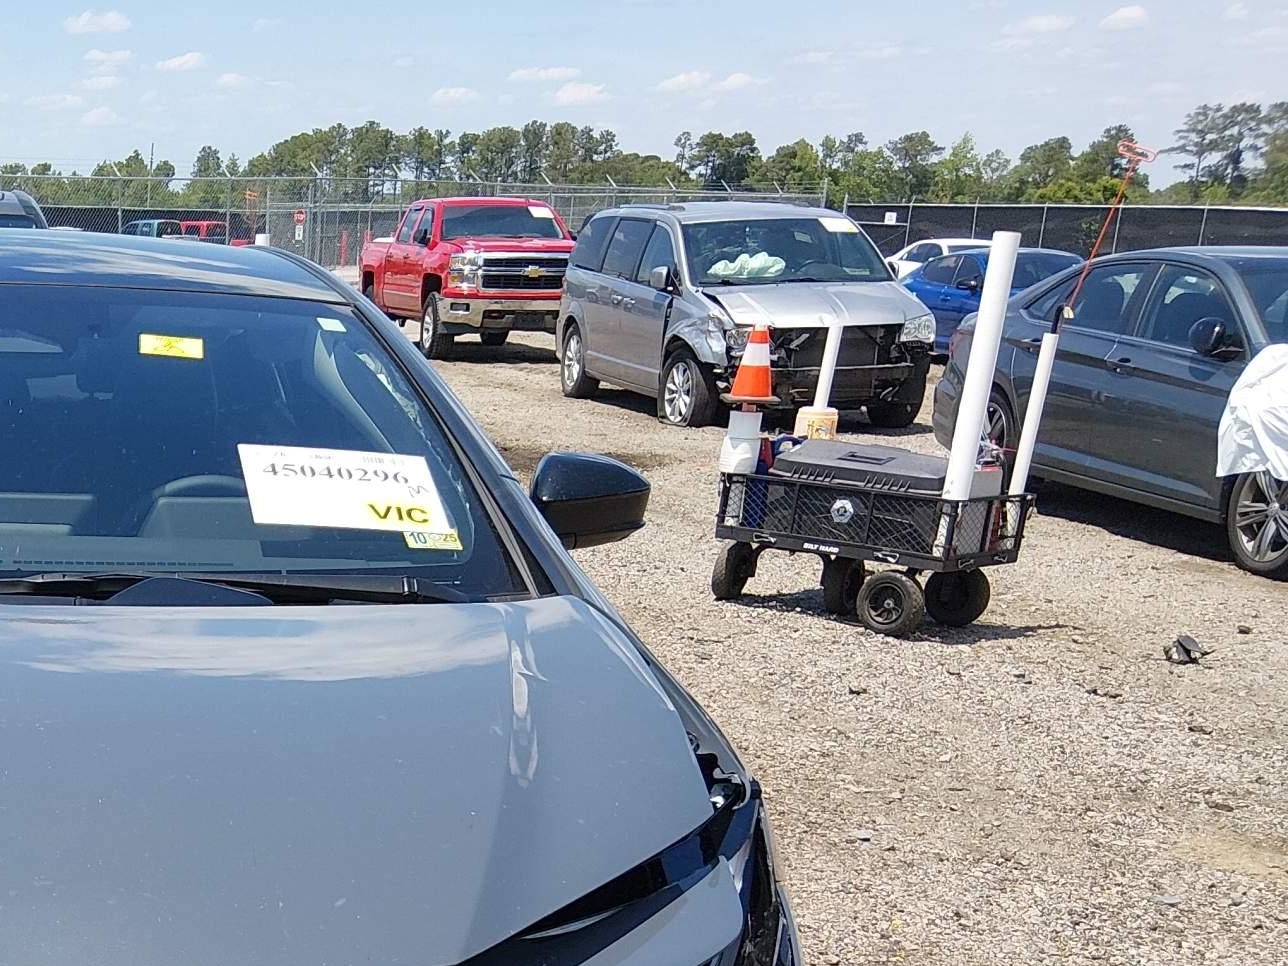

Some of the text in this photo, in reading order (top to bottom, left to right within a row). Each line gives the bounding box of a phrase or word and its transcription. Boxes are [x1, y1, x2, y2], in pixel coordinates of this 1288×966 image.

[263, 462, 409, 484] 45040296
[368, 503, 430, 524] VIC
[409, 531, 428, 545] 10
